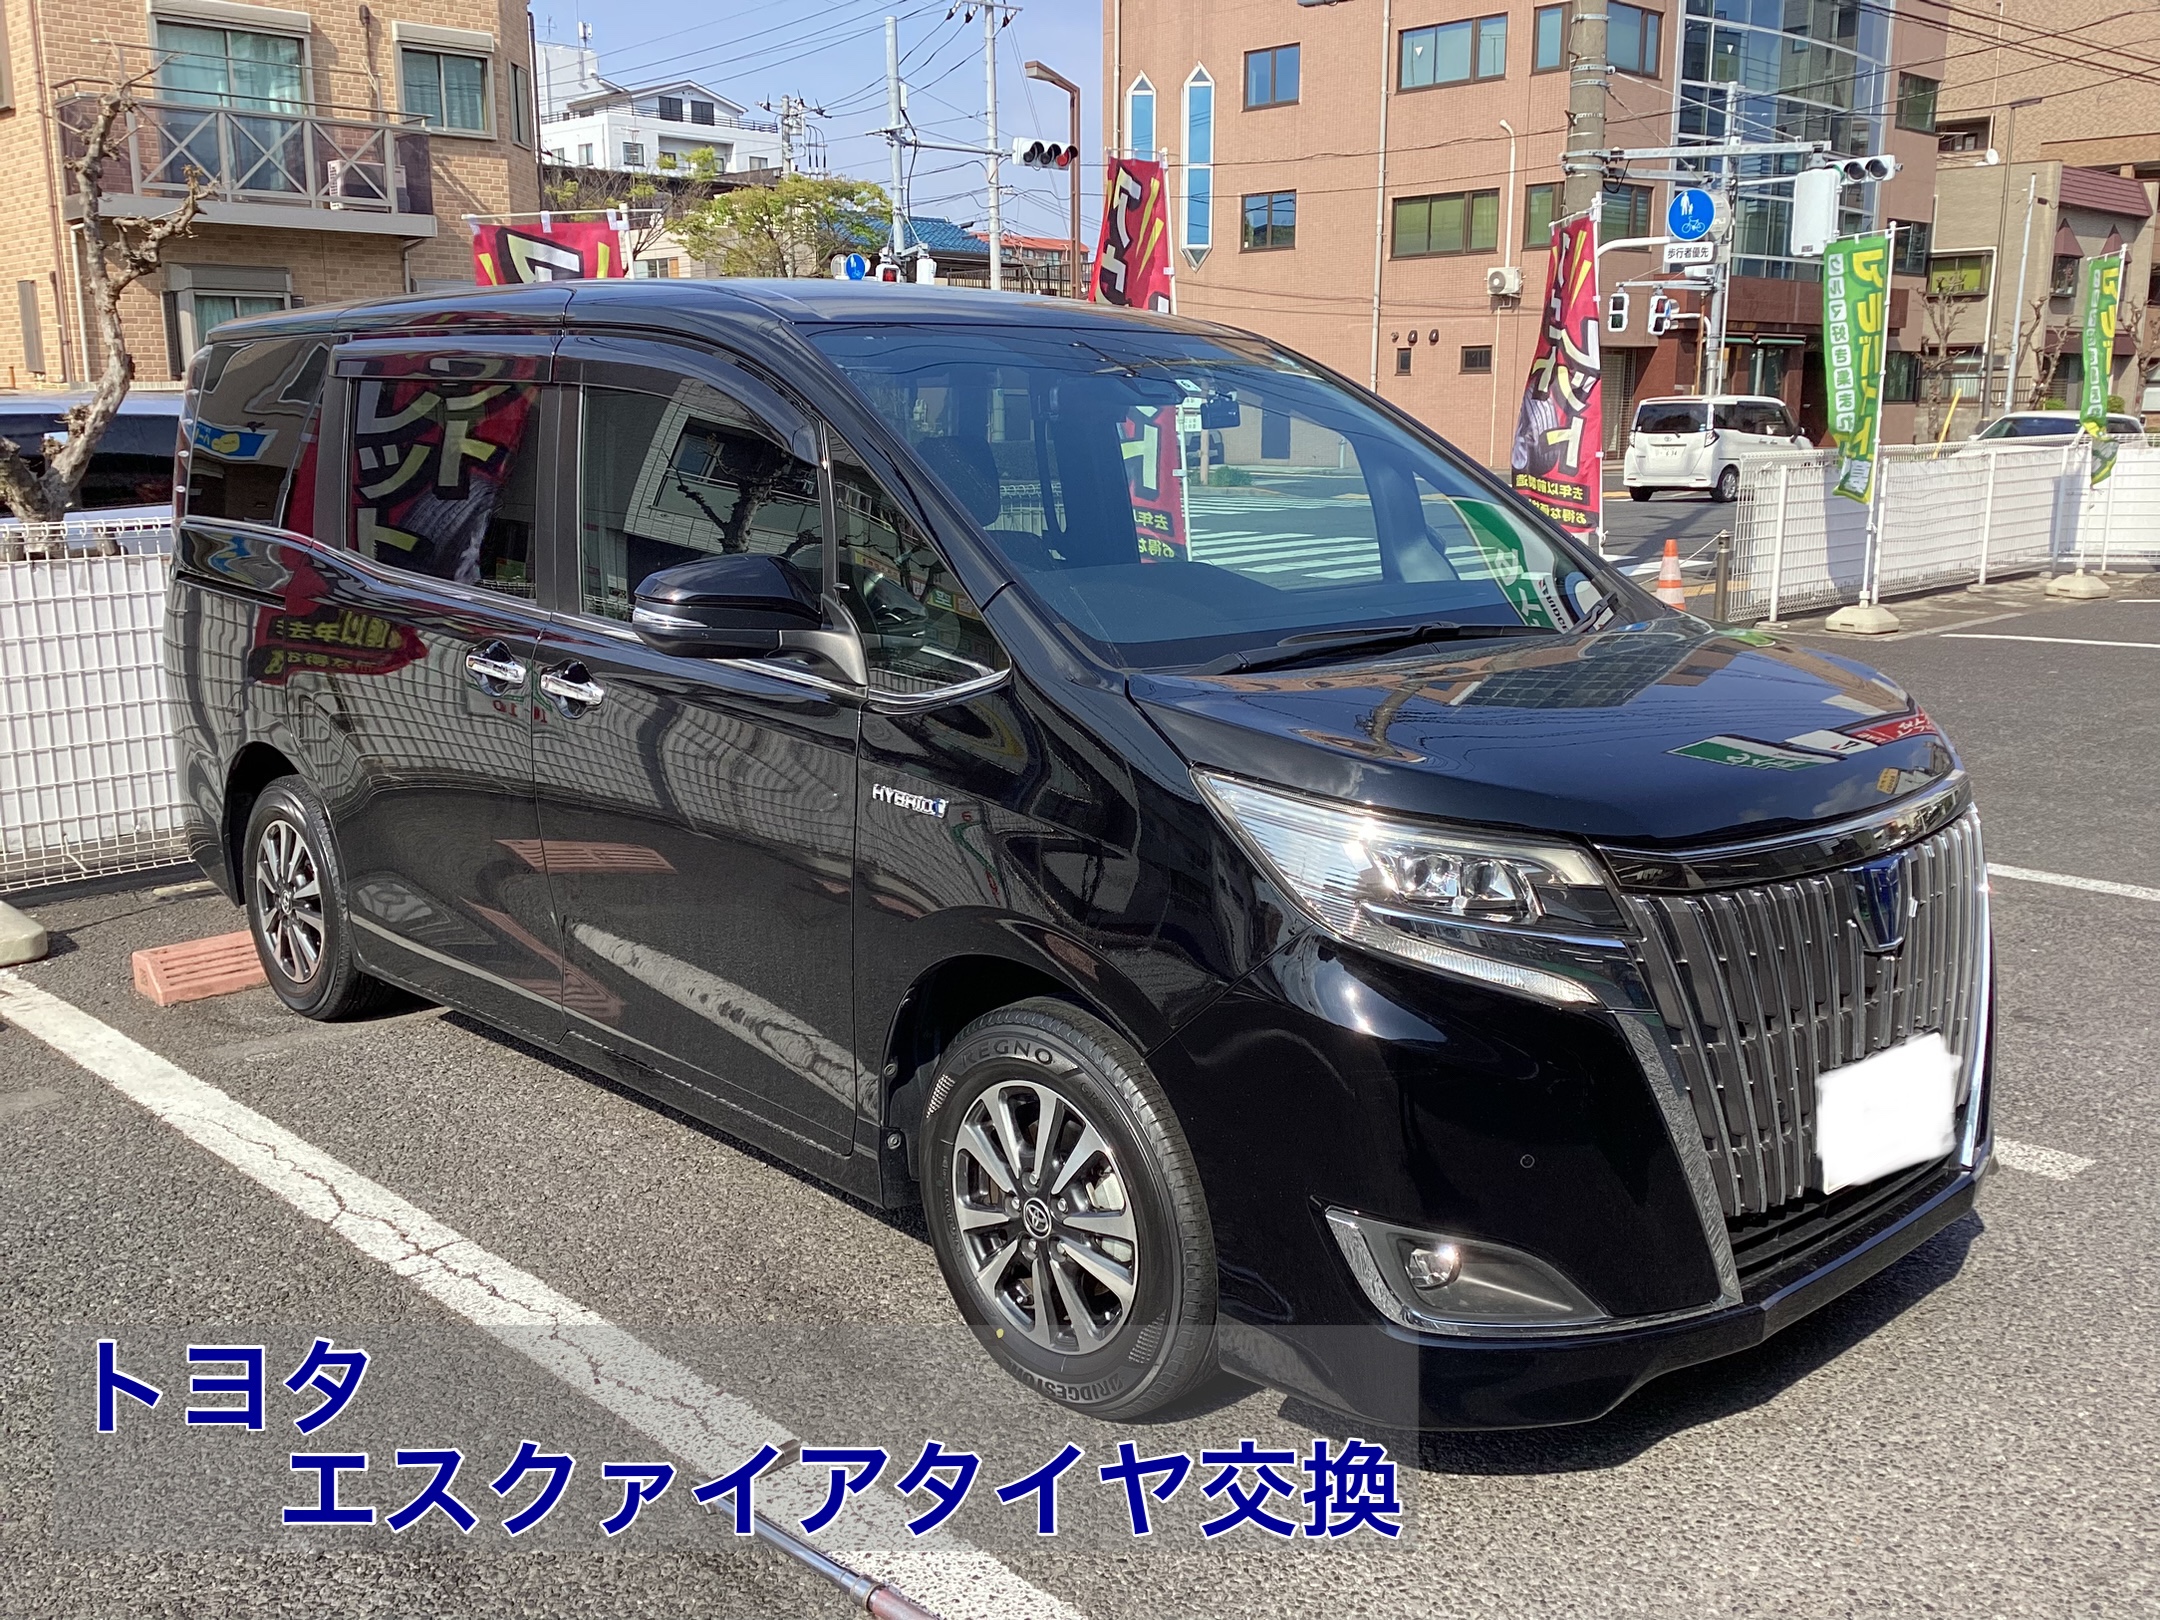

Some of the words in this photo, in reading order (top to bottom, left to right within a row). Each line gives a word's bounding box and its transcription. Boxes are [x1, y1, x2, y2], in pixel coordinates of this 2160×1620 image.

[1667, 246, 1709, 259] 歩行者優先
[872, 783, 935, 815] HYBRID
[960, 1038, 1053, 1067] REGNO
